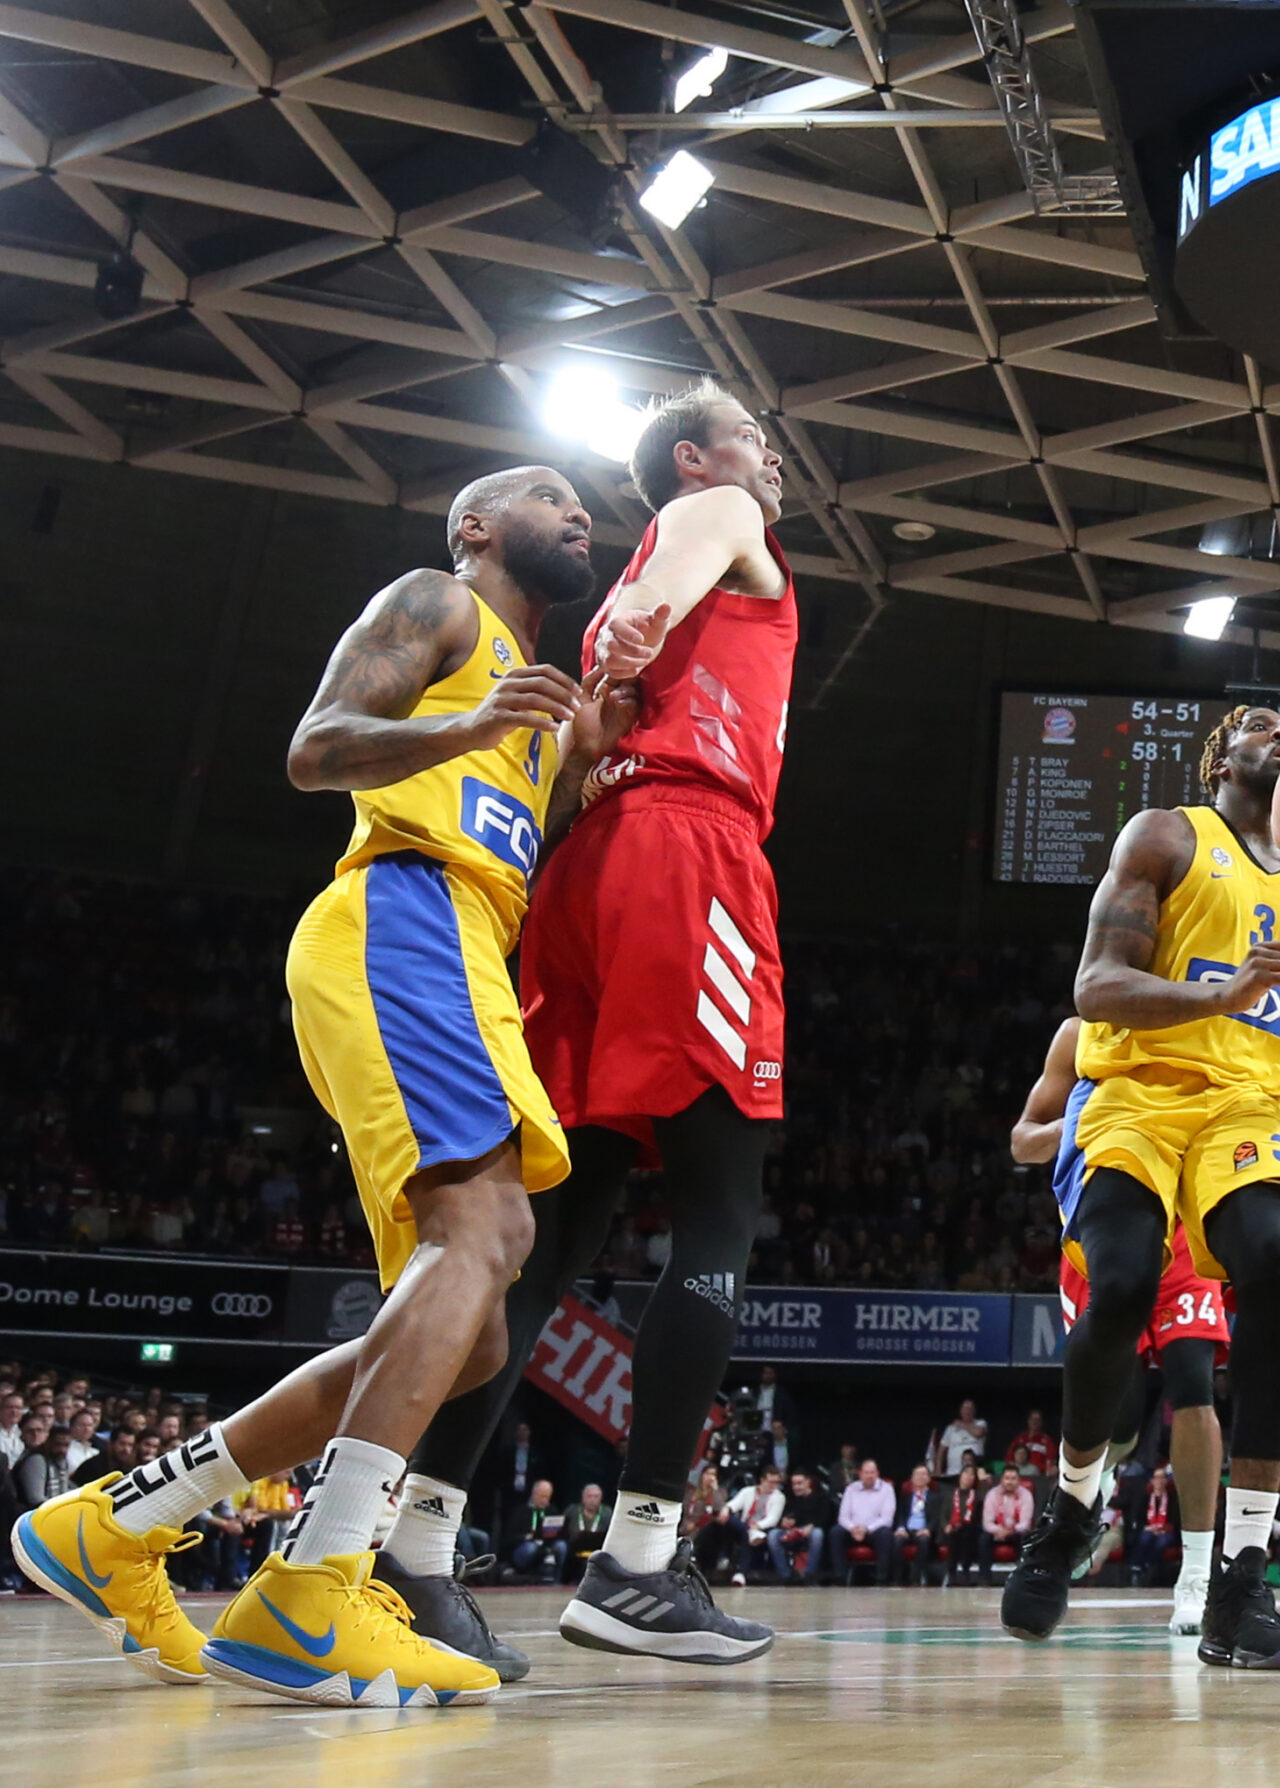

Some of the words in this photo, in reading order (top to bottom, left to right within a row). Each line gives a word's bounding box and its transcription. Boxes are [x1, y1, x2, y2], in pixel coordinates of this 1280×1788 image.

[1033, 696, 1046, 705] FC
[1048, 697, 1088, 707] BAYERN
[1160, 728, 1194, 739] Quarter
[1040, 756, 1070, 767] BRAY
[1040, 767, 1067, 778] KING
[1040, 778, 1093, 789] KOPONEN
[1040, 789, 1088, 799] MONROE
[1040, 799, 1055, 809] LO
[1039, 810, 1092, 820] DJEDOVIC
[474, 795, 539, 876] FO
[1038, 831, 1105, 842] FLACCADORI
[1250, 903, 1276, 946] 3
[0, 1281, 80, 1306] Dome
[88, 1287, 193, 1316] Lounge
[683, 1276, 736, 1318] adidas
[739, 1301, 822, 1329] RMER
[1174, 1292, 1218, 1326] 34
[854, 1303, 981, 1332] HIRMER
[857, 1336, 908, 1351] GROSSE
[914, 1337, 976, 1353] GRÖSSEN
[413, 1502, 450, 1520] adidas
[627, 1509, 666, 1524] adidas
